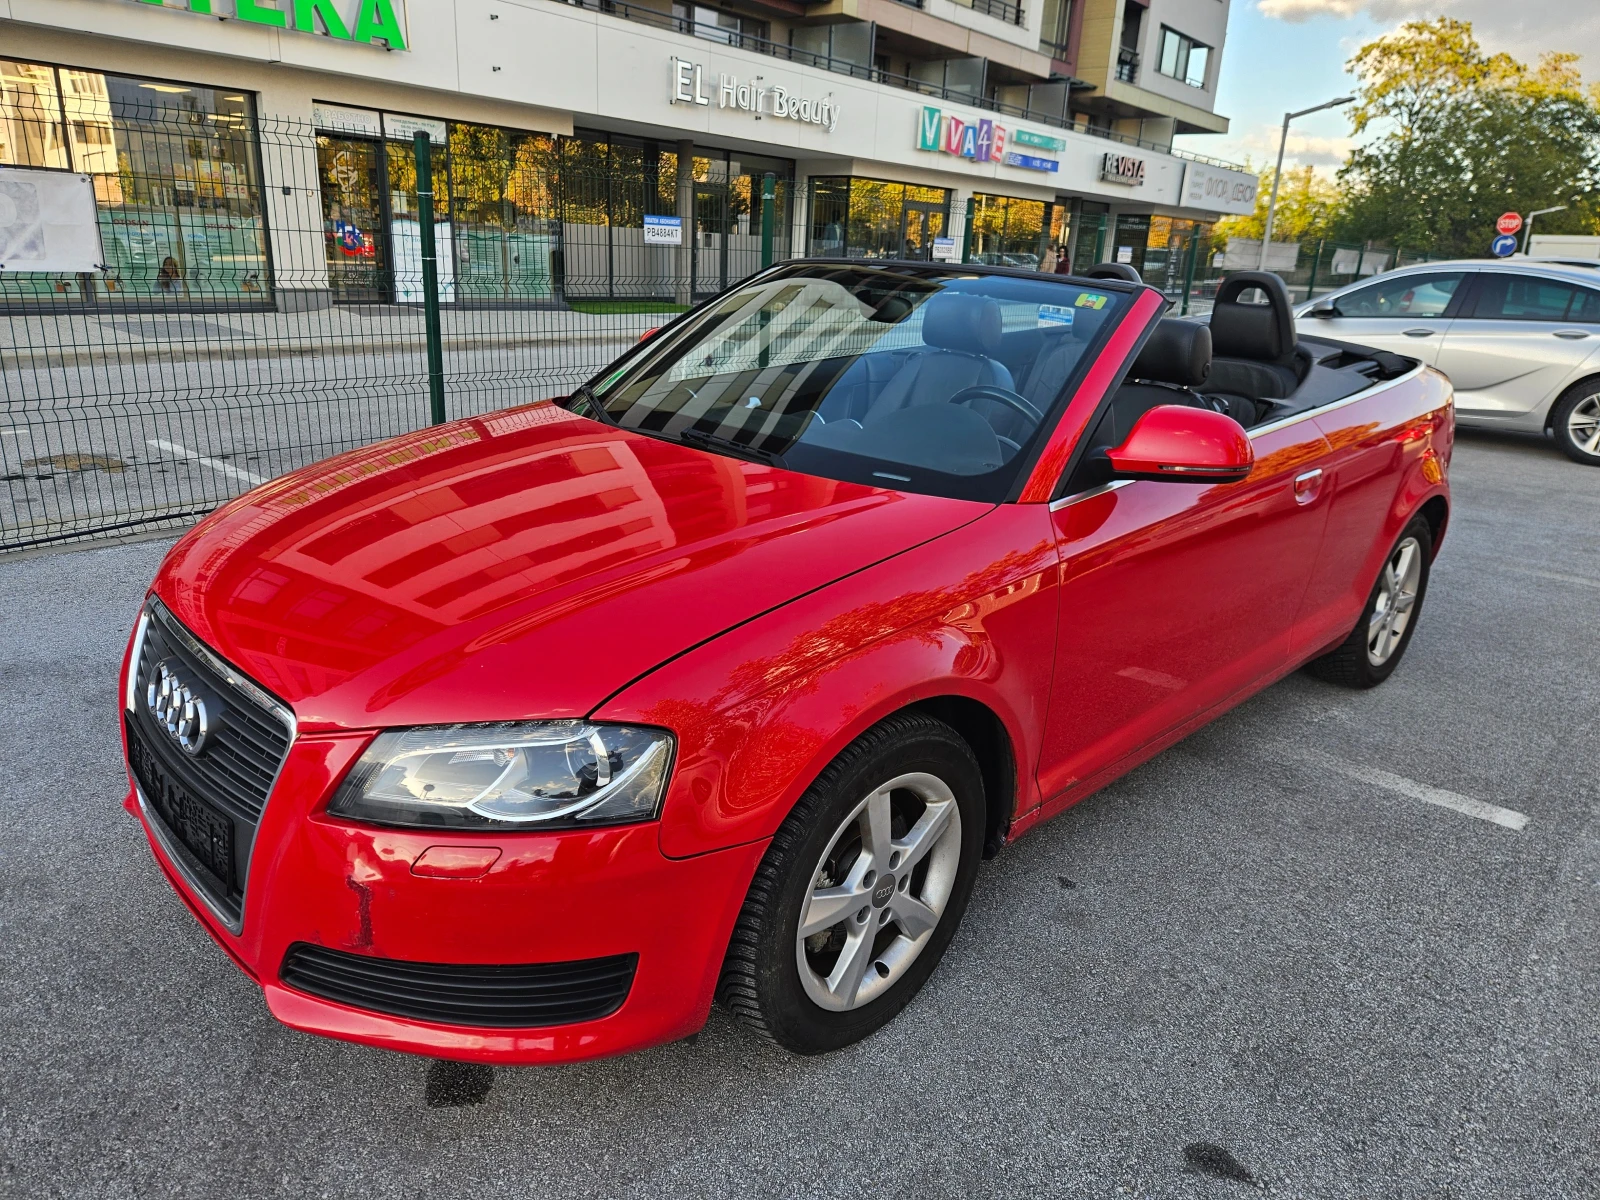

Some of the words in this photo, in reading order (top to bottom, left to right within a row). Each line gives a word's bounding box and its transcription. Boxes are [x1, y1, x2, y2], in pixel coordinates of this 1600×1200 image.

[675, 57, 709, 106] EL
[719, 73, 766, 113] Hair
[771, 85, 841, 134] Beauty
[323, 108, 372, 125] РАБОТНО
[1103, 153, 1146, 178] REVISTA
[1500, 219, 1519, 229] STOP
